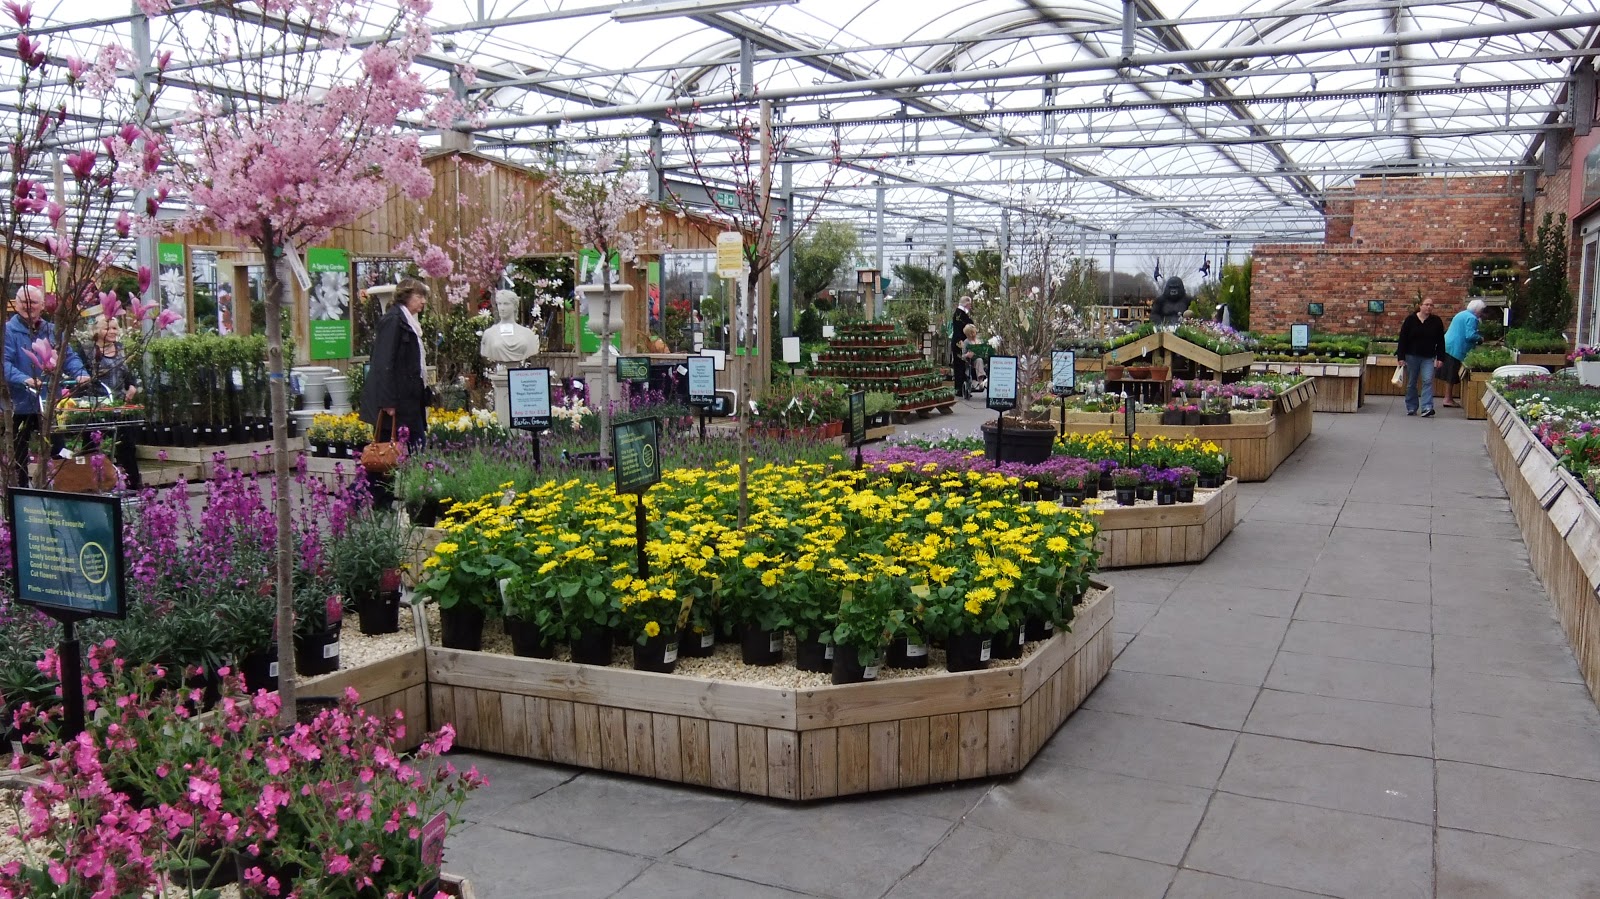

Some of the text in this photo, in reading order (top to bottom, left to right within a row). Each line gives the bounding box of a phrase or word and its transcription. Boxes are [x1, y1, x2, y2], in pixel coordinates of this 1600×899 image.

[316, 263, 329, 271] Spring
[514, 417, 549, 426] Barton Grange
[28, 533, 39, 542] Easy
[29, 542, 63, 554] Long flowering
[30, 552, 44, 560] Lovely
[44, 554, 60, 562] border
[30, 560, 42, 569] Good
[50, 564, 76, 574] containers
[39, 571, 57, 580] flowers
[28, 584, 41, 592] Plants
[45, 588, 63, 596] nature's
[63, 589, 75, 598] fresh
